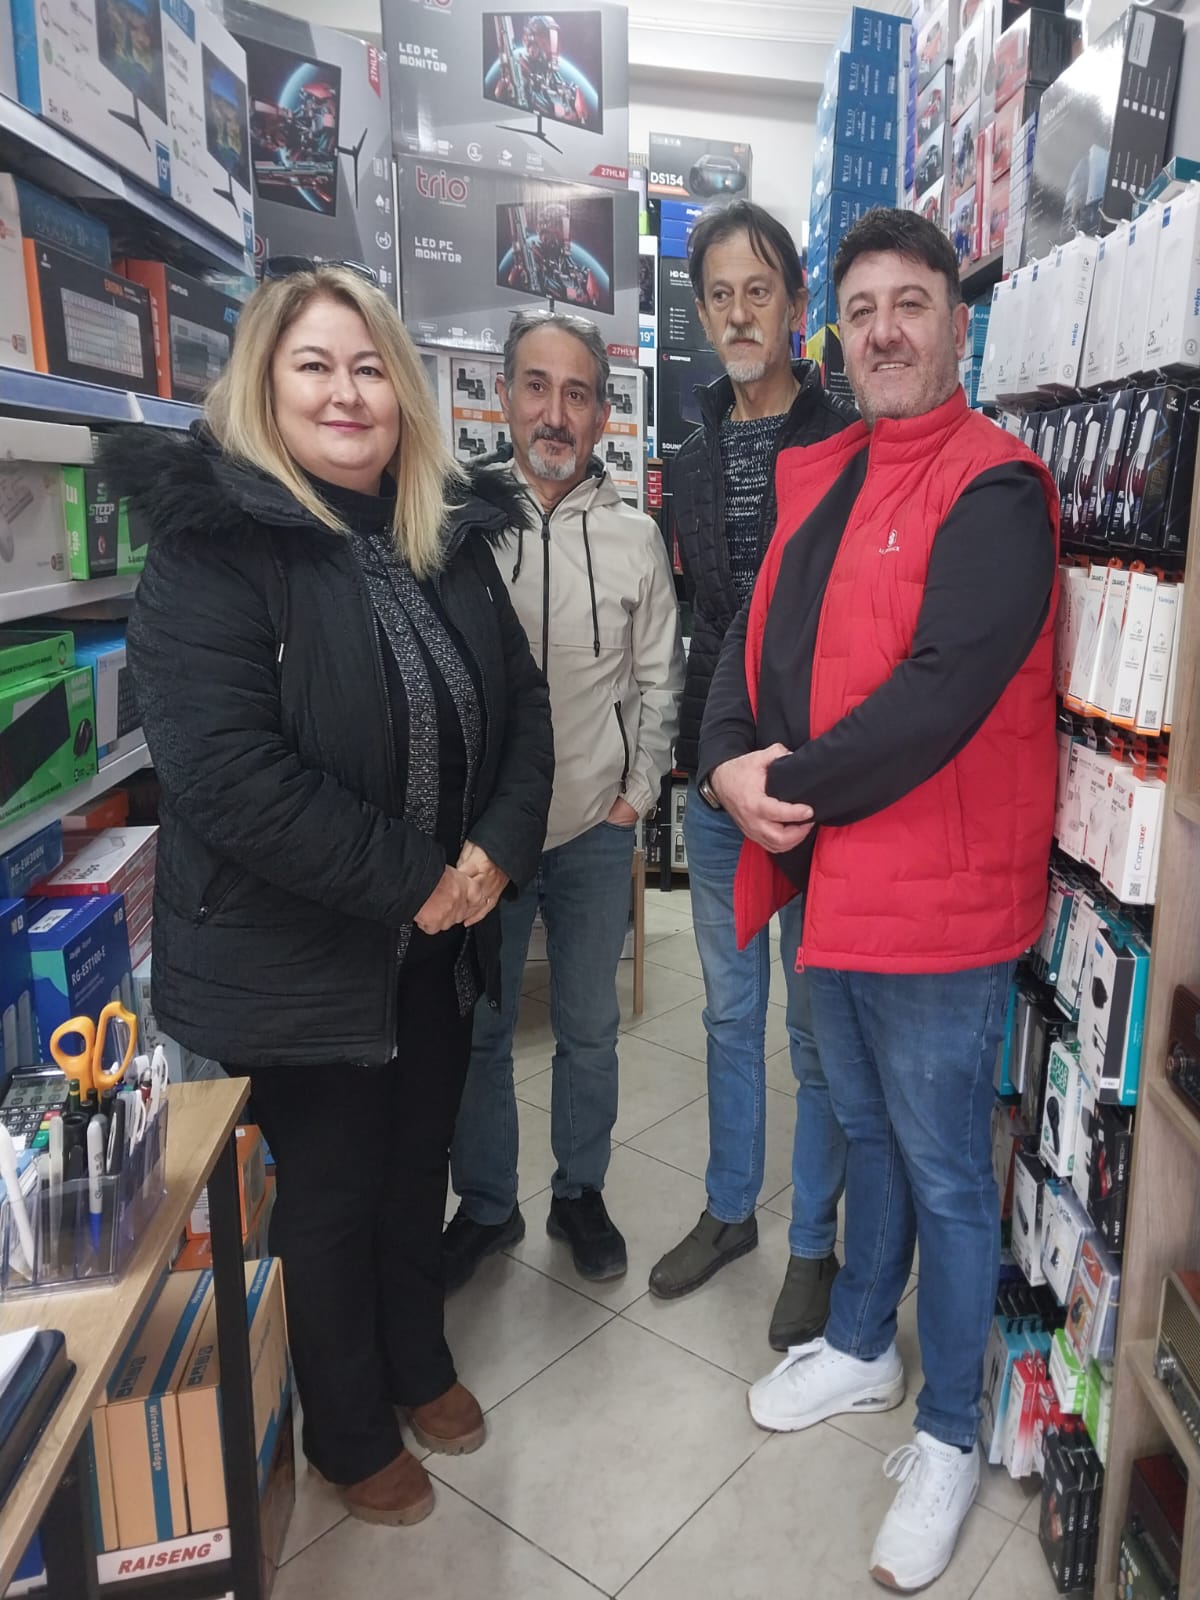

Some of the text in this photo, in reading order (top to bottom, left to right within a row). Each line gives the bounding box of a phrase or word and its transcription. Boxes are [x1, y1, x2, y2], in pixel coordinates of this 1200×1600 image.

[399, 42, 439, 59] LED PC
[399, 56, 448, 73] MONITOR
[601, 168, 626, 179] 27HLM
[650, 172, 684, 186] DS154
[415, 165, 468, 202] trio
[414, 236, 453, 251] LED PC
[415, 248, 462, 263] MONITOR
[149, 1405, 161, 1471] Wireless Bridge
[117, 1543, 212, 1576] RAISENG
